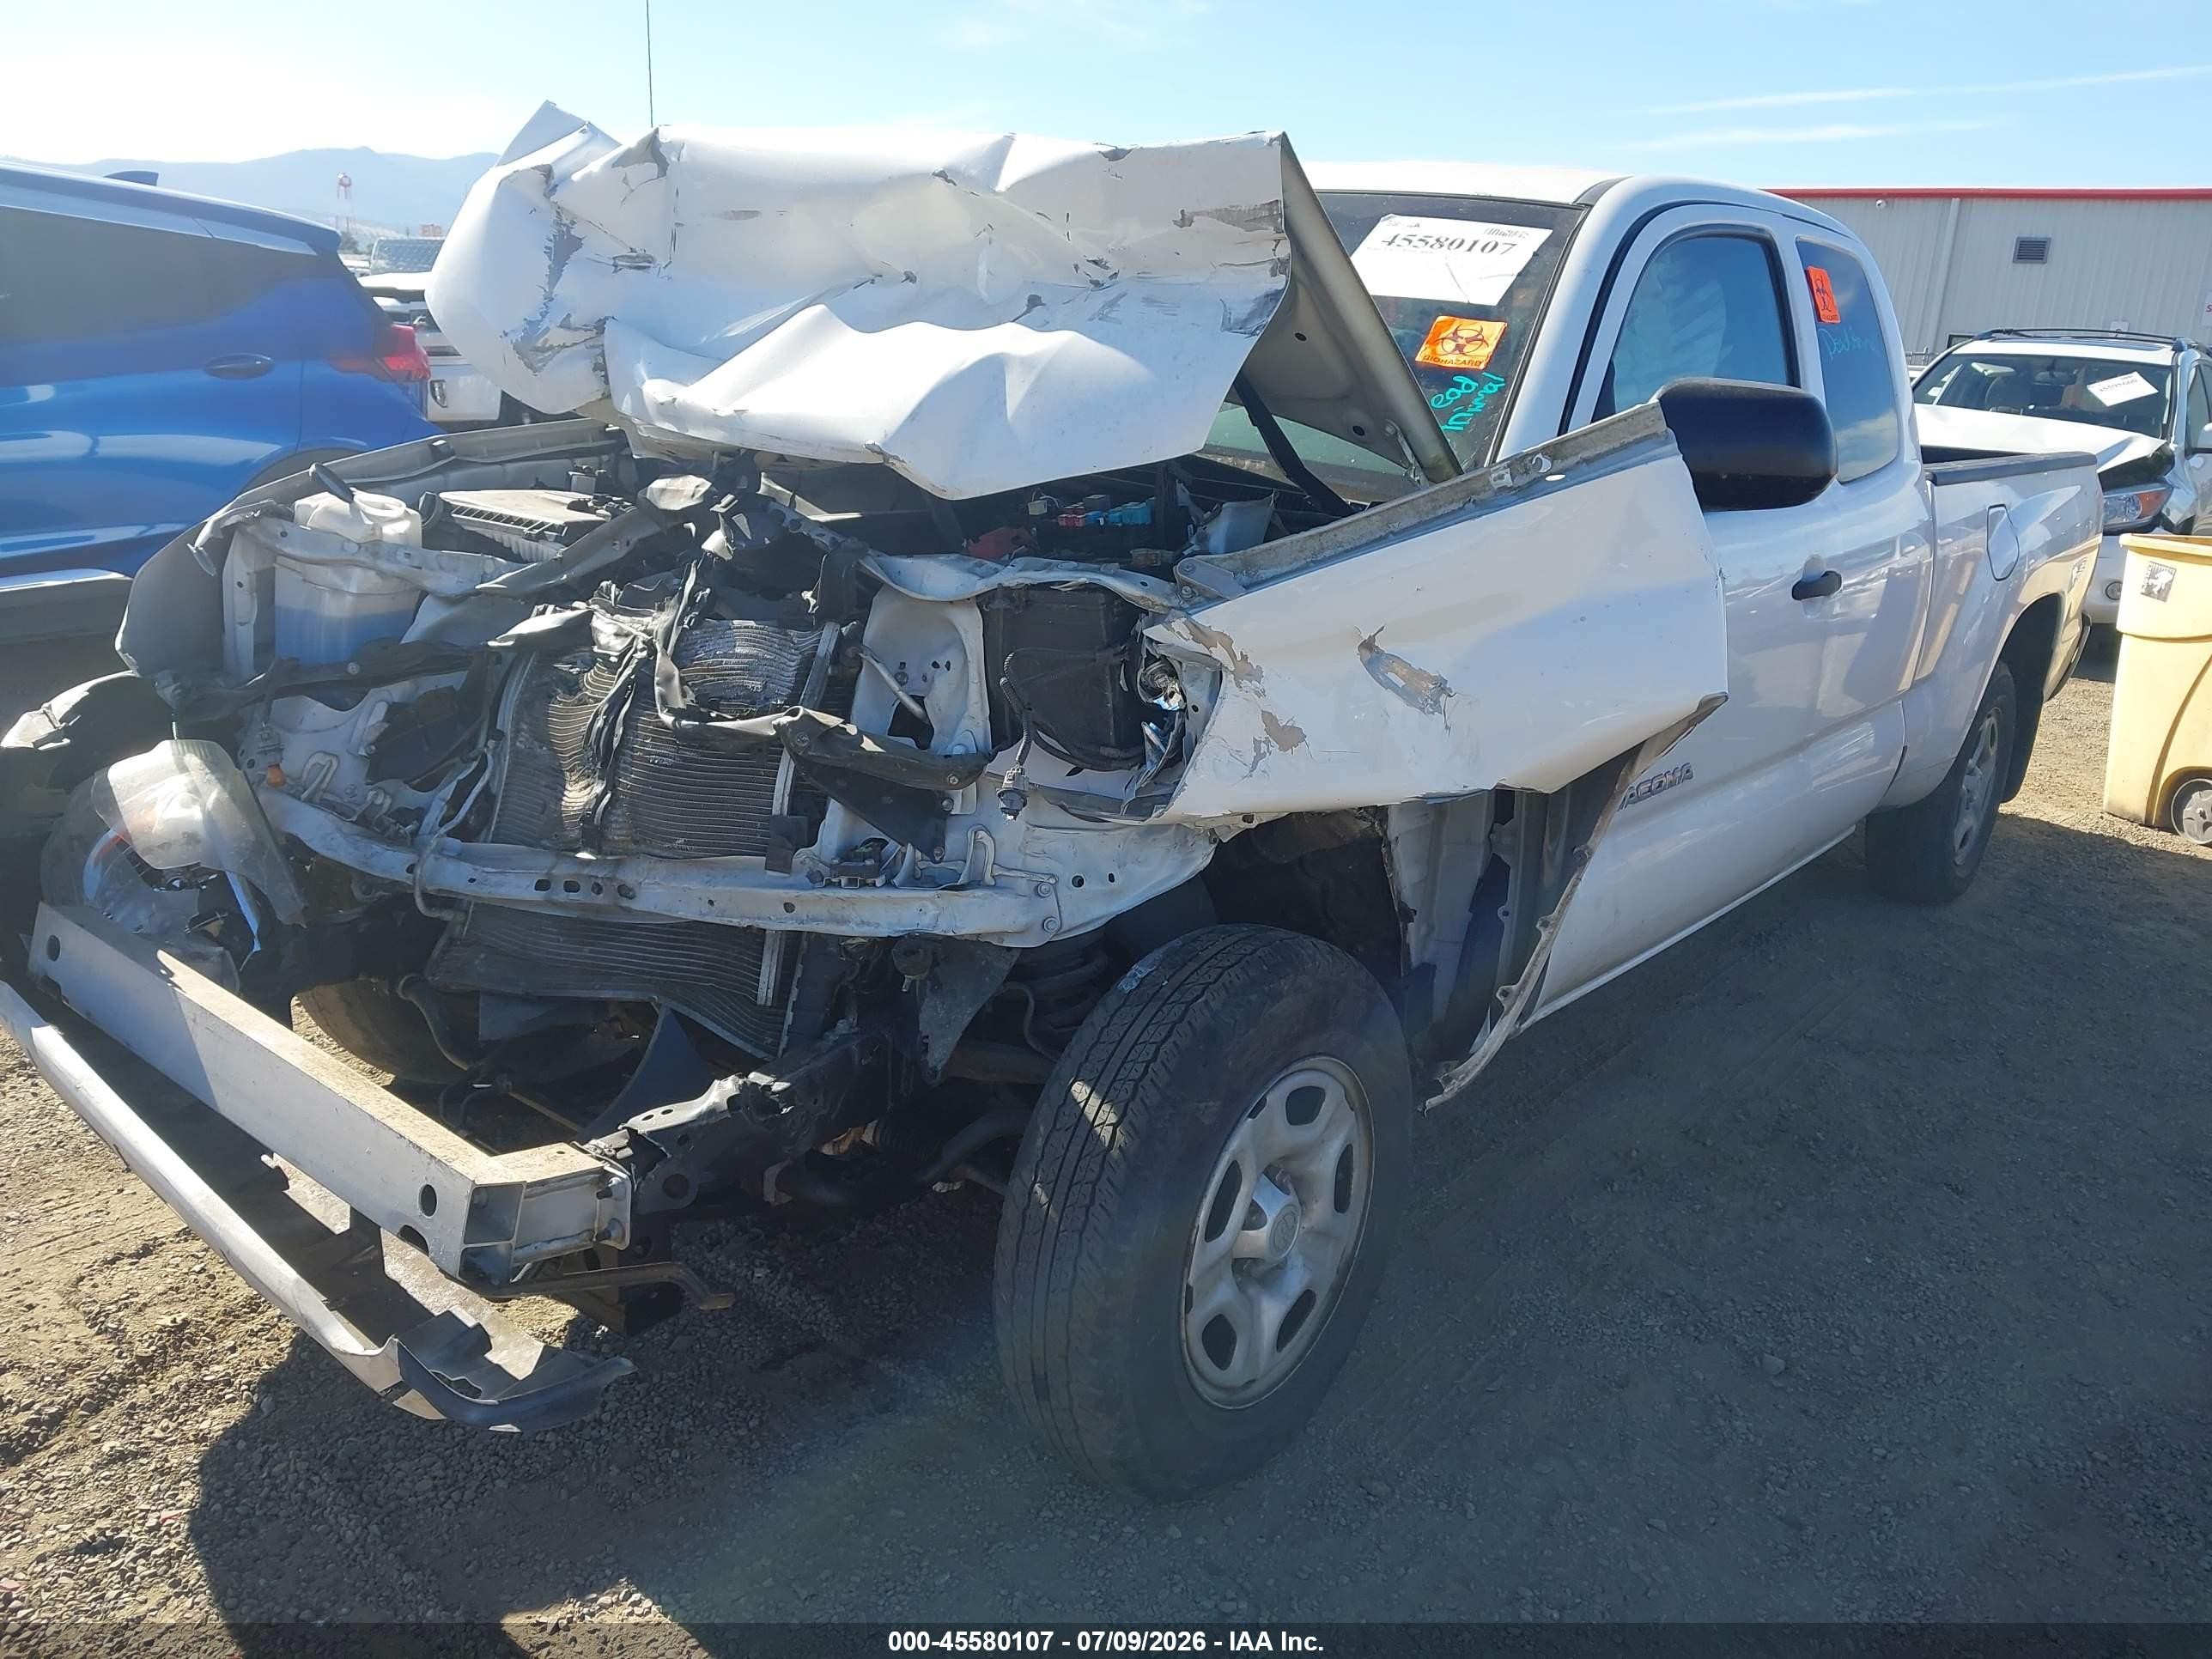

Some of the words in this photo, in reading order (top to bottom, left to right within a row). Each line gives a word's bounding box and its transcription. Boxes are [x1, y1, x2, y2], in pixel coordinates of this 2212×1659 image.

[1381, 232, 1518, 256] 45580107
[1422, 354, 1483, 367] BIOHAZARD
[1431, 374, 1478, 409] ead
[1441, 372, 1505, 431] nimal
[1616, 763, 1694, 811] ACOMA
